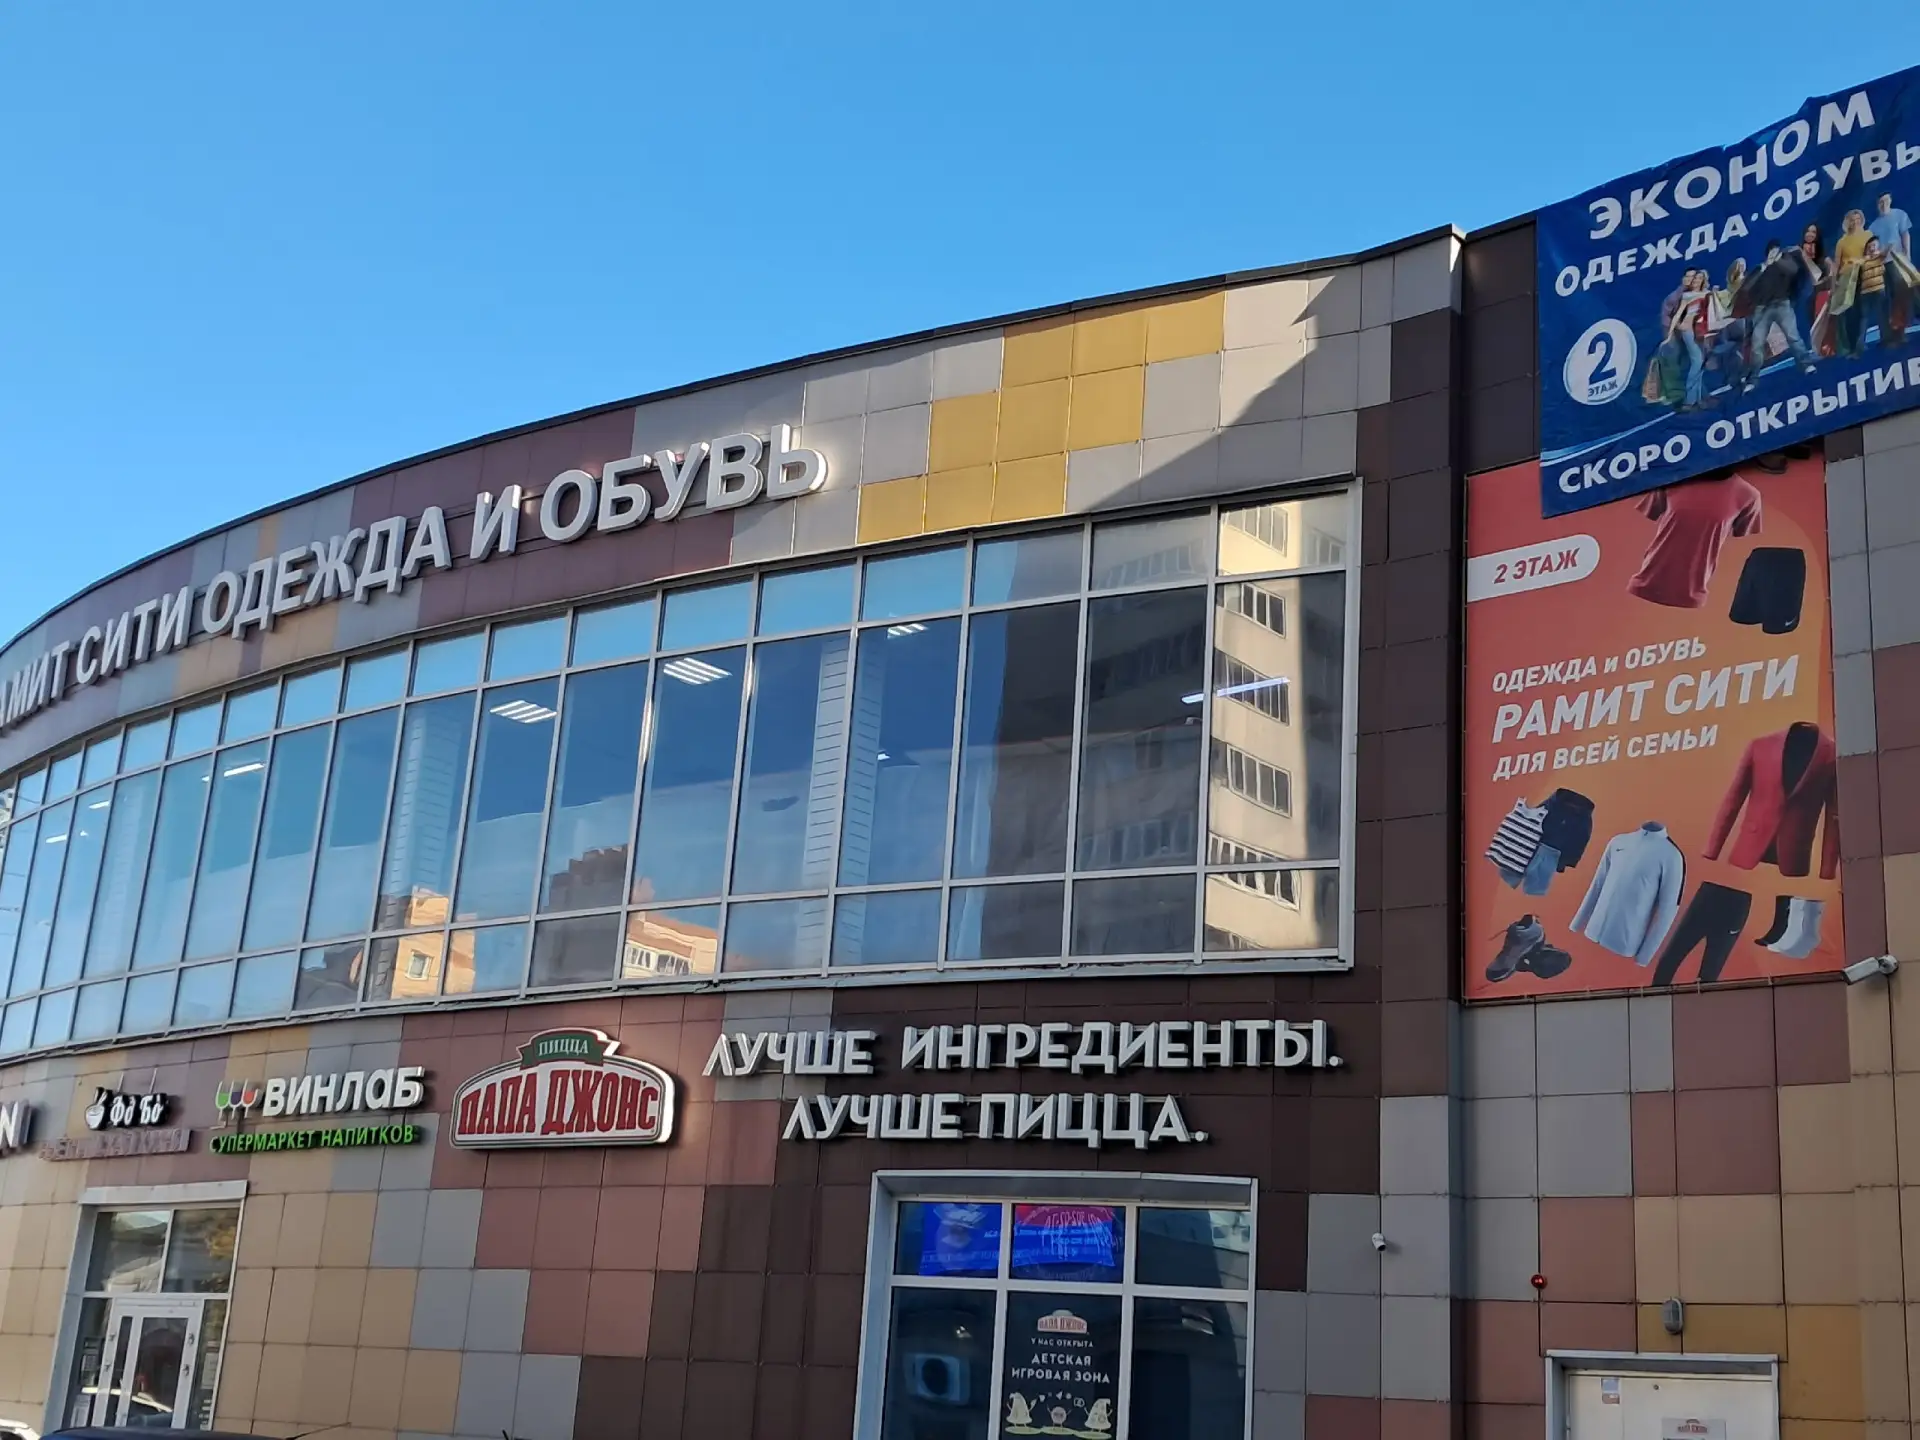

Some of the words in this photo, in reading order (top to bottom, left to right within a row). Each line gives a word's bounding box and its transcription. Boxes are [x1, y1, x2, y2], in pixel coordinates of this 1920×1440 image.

[1589, 90, 1875, 239] ЭКОНОМ
[1587, 331, 1616, 386] 2
[1587, 379, 1618, 397] ЭТАЖ
[1558, 433, 1691, 494] СКОРО
[75, 586, 197, 686] СИТИ
[201, 506, 452, 641] ОДЕЖДА
[469, 484, 523, 562] И
[539, 424, 828, 543] ОБУВЬ
[1493, 564, 1507, 585] 2
[1512, 547, 1581, 582] ЭТАЖ
[1492, 655, 1597, 694] ОДЕЖДА
[1624, 636, 1707, 670] ОБУВЬ
[1492, 680, 1655, 744] РАМИТ
[1664, 654, 1799, 716] СИТИ
[1492, 750, 1546, 781] ДЛЯ
[1552, 735, 1620, 770] ВСЕЙ
[1626, 724, 1718, 758] СЕМЬИ
[538, 1038, 589, 1056] ПИЦЦА
[702, 1030, 877, 1076] ЛУЧШЕ
[901, 1020, 1341, 1075] ИНГРЕДИЕНТЫ.
[458, 1072, 537, 1135] ПАПА
[782, 1093, 964, 1139] ЛУЧШЕ
[978, 1093, 1208, 1149] ПИЦЦА.
[210, 1130, 318, 1153] СУПЕРМАРКЕТ
[320, 1124, 415, 1147] НАПИТКОВ
[1031, 1353, 1092, 1367] ДЕТСКАЯ
[1038, 1338, 1054, 1346] НАС
[1056, 1339, 1094, 1348] ОТКРЫТА
[1011, 1367, 1070, 1381] ИГРОВАЯ
[1074, 1370, 1110, 1384] ЗОНА
